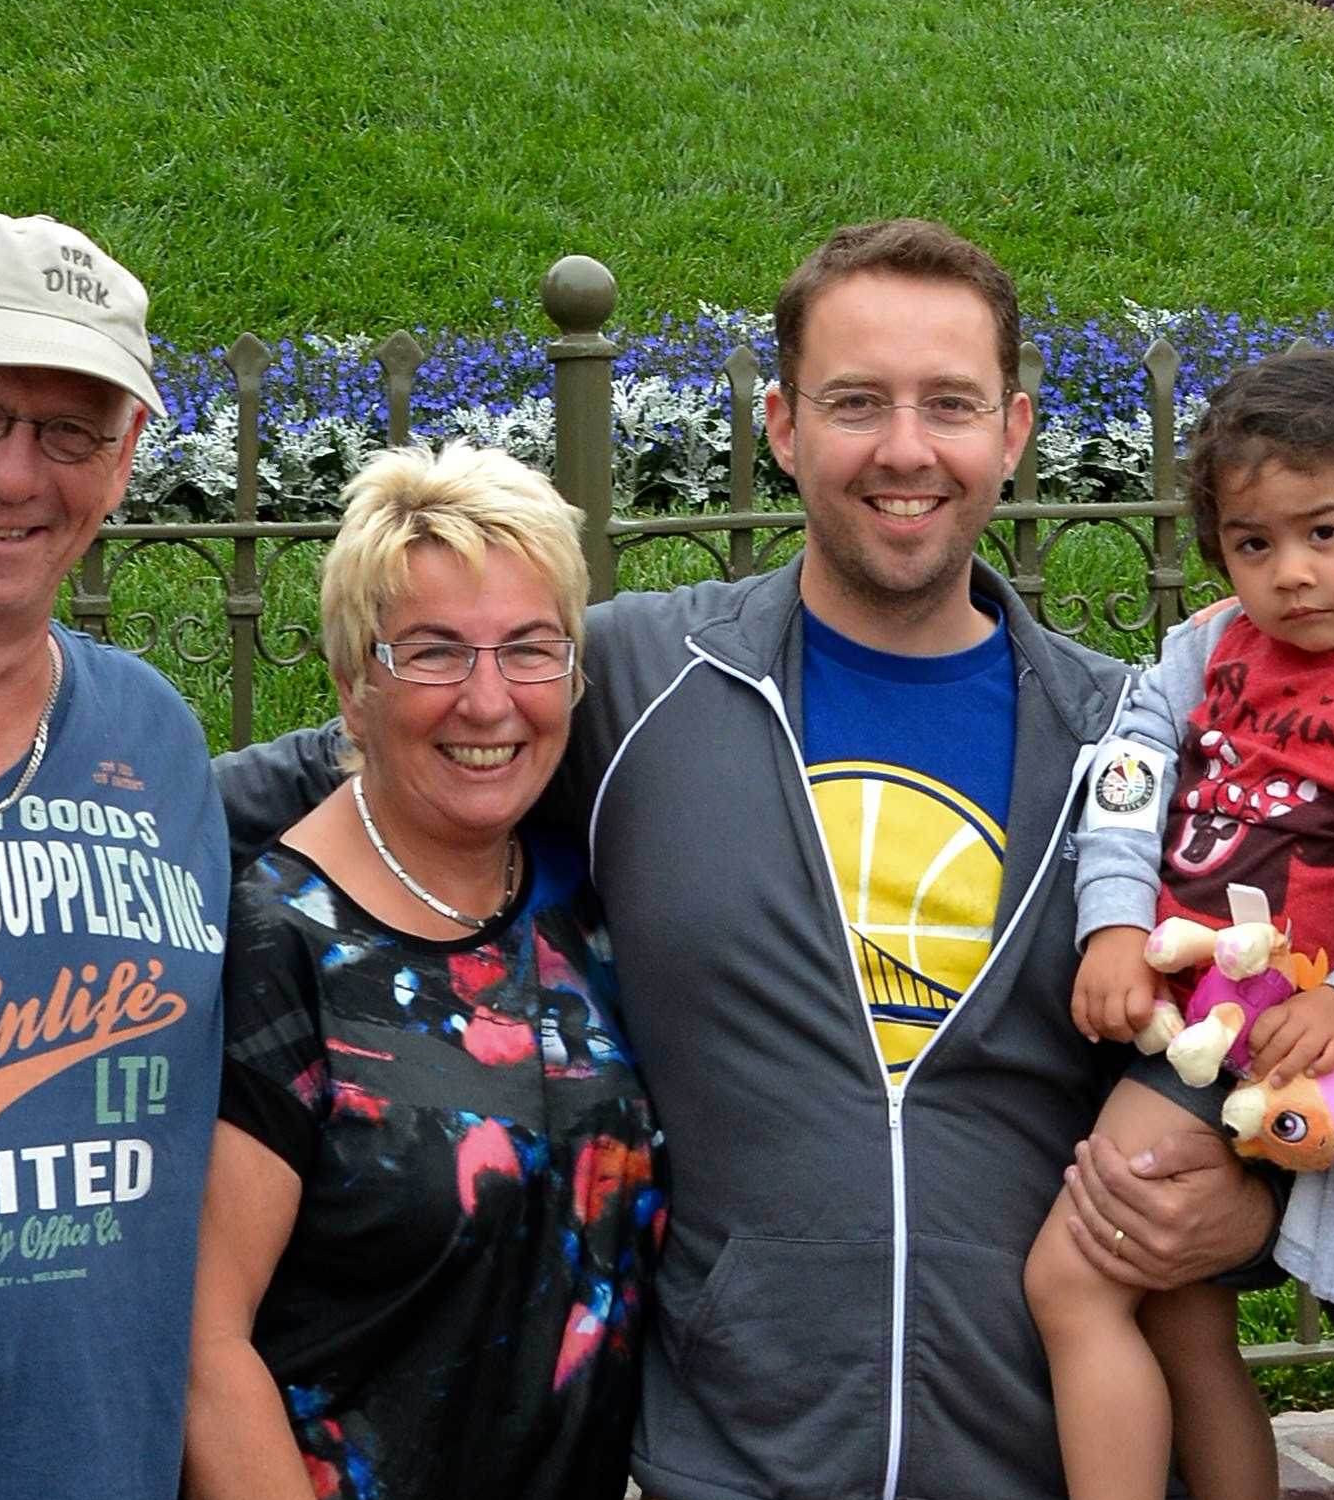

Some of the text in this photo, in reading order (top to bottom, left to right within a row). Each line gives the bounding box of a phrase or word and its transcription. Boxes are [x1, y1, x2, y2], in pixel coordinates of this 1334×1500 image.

[61, 245, 93, 270] OPA
[43, 267, 110, 309] DIRK
[19, 795, 160, 849] GOODS
[95, 1055, 169, 1124] LTD
[20, 1214, 91, 1260] Office
